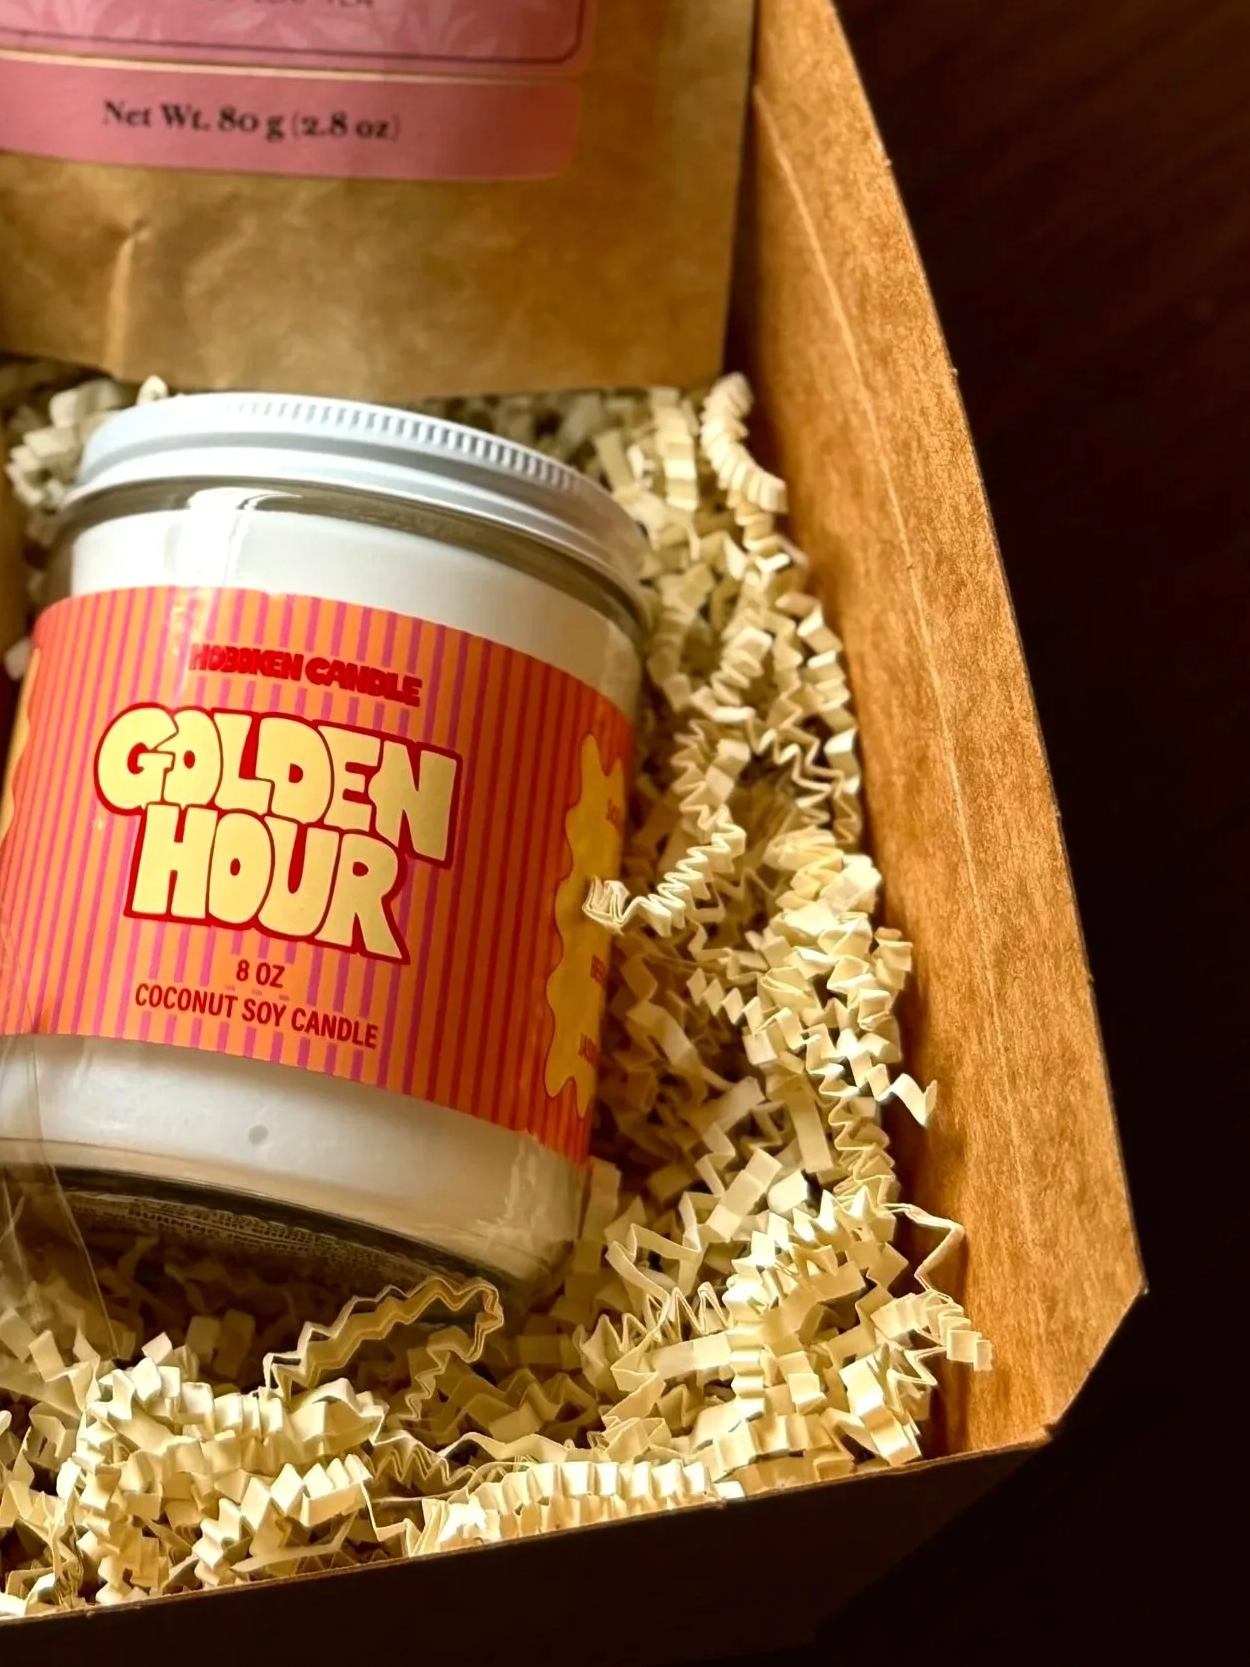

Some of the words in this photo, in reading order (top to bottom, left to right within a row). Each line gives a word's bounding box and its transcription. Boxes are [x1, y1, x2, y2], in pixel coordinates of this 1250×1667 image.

[103, 101, 152, 128] Net
[159, 104, 210, 132] Wt.
[218, 107, 258, 134] 80
[265, 116, 284, 143] g
[290, 111, 349, 140] (2.8
[355, 114, 402, 142] oz)
[188, 642, 304, 682] HOBOKEN
[304, 657, 423, 708] CANDLE
[94, 701, 462, 869] GOLDEN
[124, 801, 410, 966] HOUR
[236, 959, 250, 982] 8
[255, 962, 285, 989] OZ
[135, 983, 239, 1018] COCONUT
[241, 998, 287, 1027] SOY
[291, 1008, 379, 1049] CANDLE
